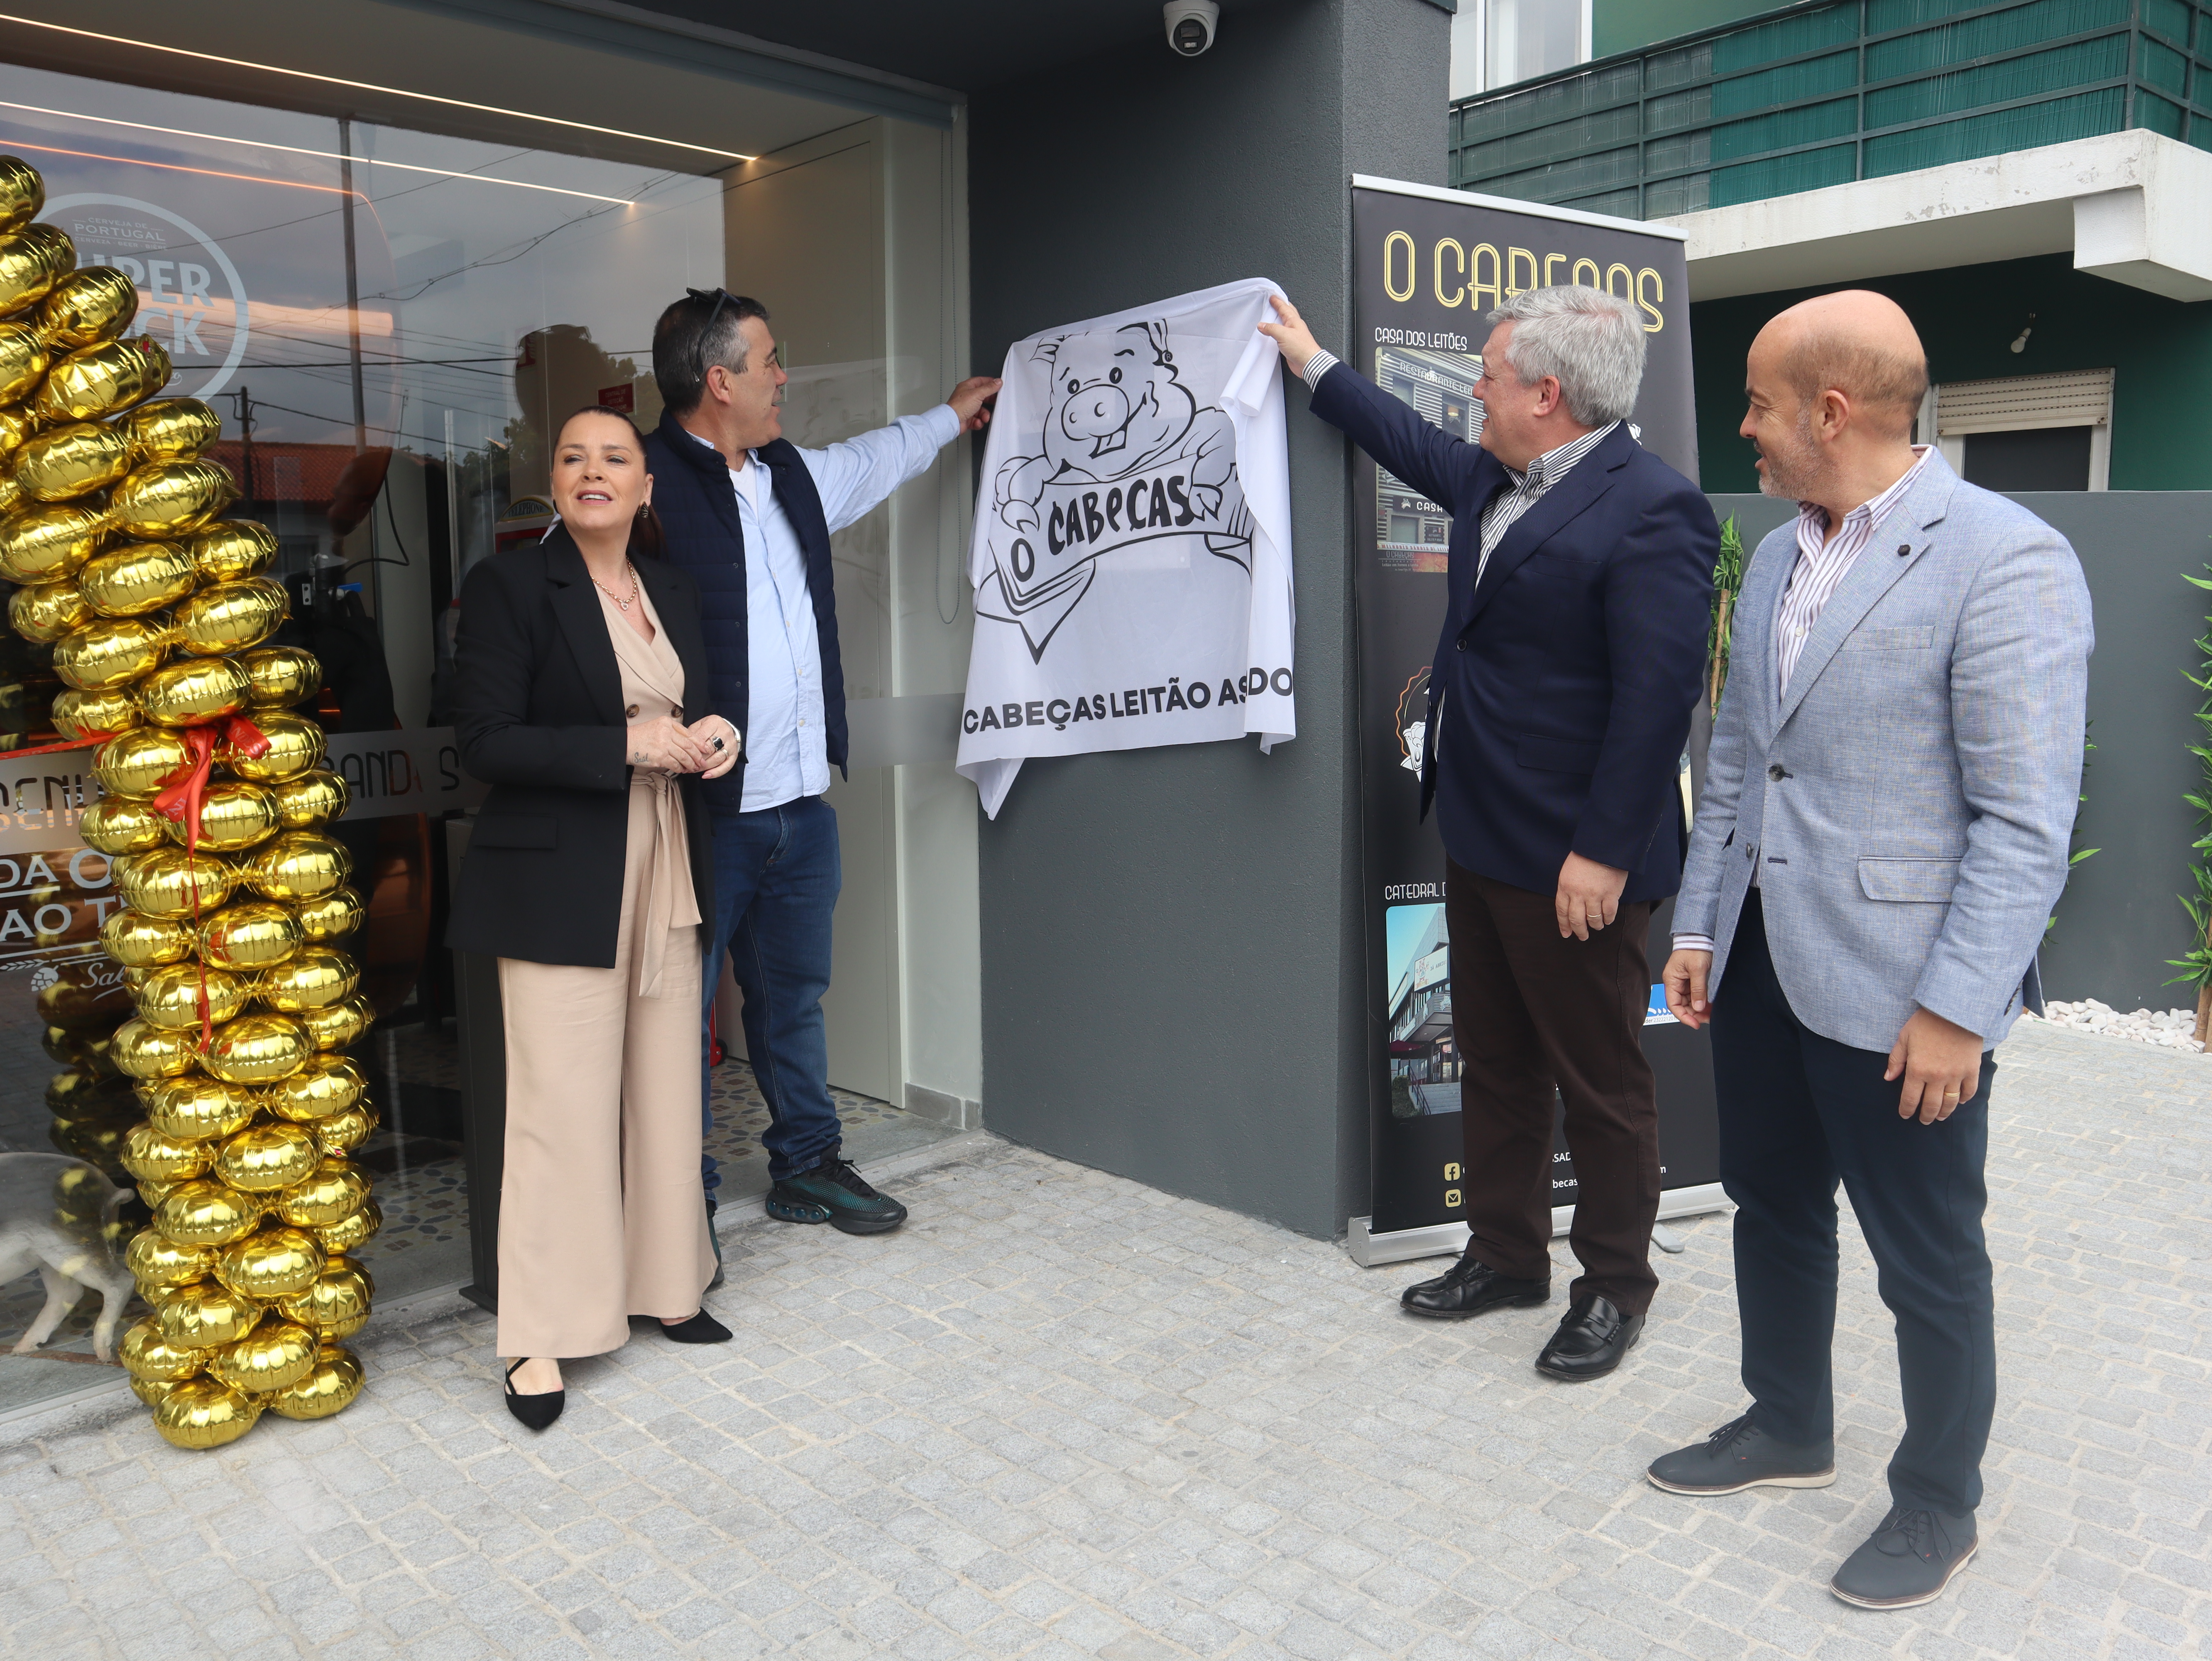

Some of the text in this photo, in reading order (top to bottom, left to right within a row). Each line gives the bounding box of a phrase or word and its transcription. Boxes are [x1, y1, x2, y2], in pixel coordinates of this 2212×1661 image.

[74, 223, 166, 241] PORTUGAL
[88, 218, 132, 227] CERVEJA
[76, 252, 214, 307] PER
[1384, 230, 1415, 301] O
[1375, 327, 1467, 351] CASA DOS LEITÕES
[1400, 361, 1456, 391] RESTAURANTE
[1459, 384, 1473, 396] LEIT
[508, 502, 544, 517] TELEPHONE
[1011, 538, 1035, 582] O
[964, 693, 1106, 735] CABEÇAS
[1110, 677, 1211, 718] LEITÃO
[1385, 882, 1440, 900] CATEDRAL
